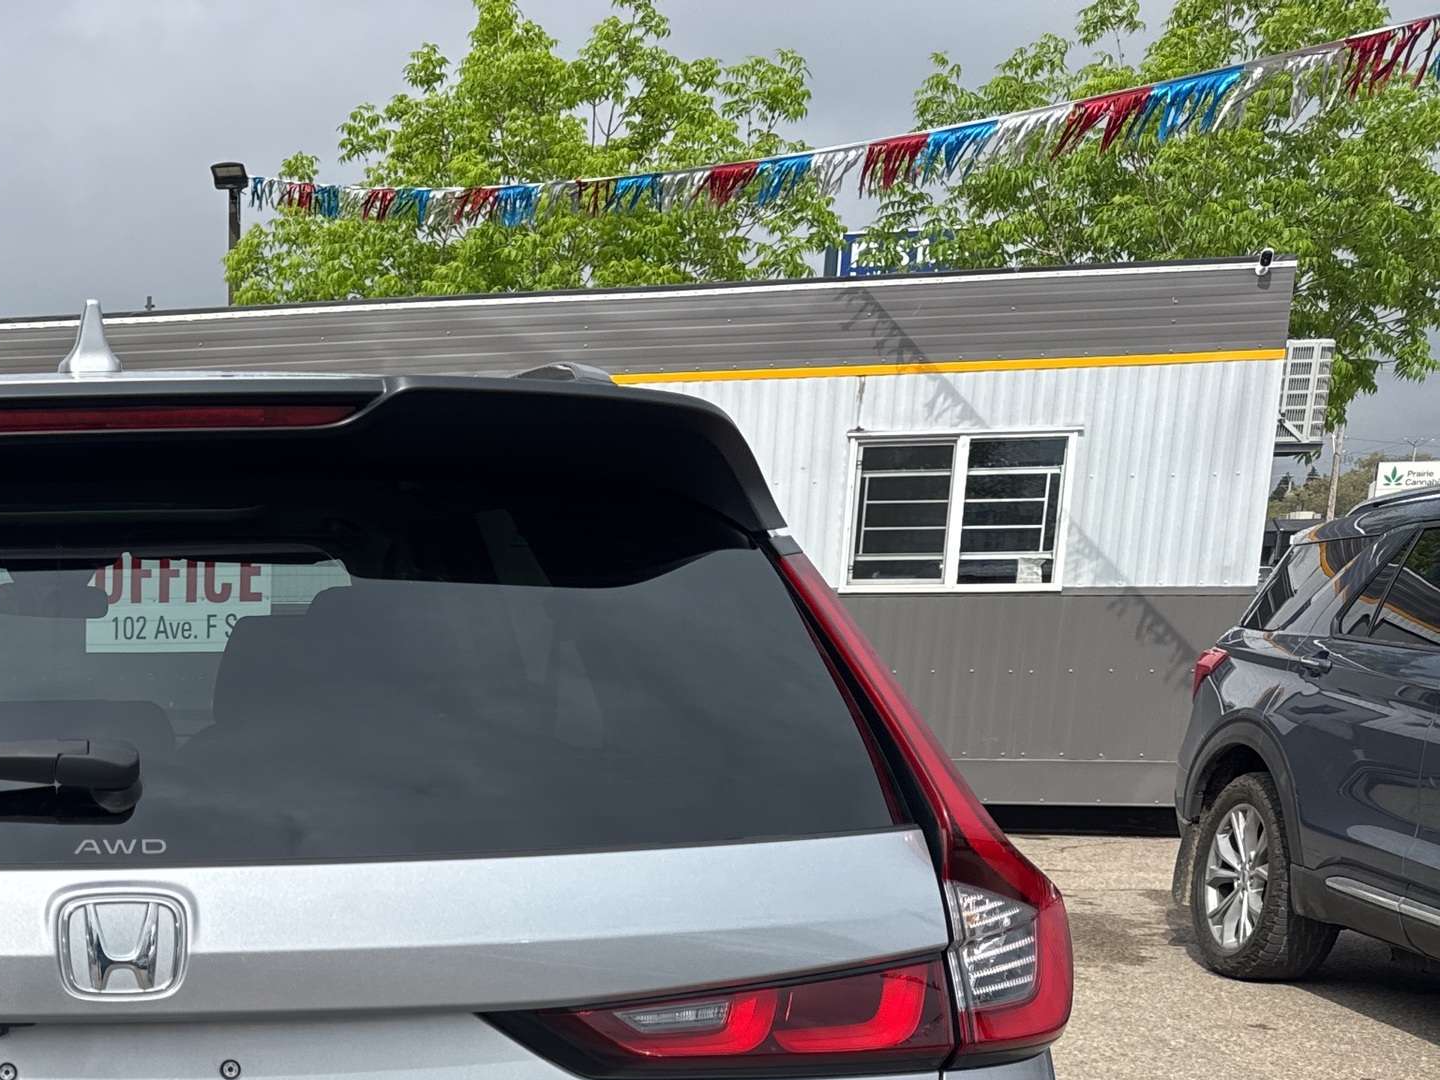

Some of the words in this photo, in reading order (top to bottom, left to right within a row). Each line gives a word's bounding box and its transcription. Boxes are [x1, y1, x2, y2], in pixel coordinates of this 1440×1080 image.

[1407, 470, 1434, 478] Prairie
[95, 557, 263, 604] OFFICE
[112, 615, 147, 640] 102
[154, 615, 198, 640] Ave.
[206, 614, 218, 639] F
[74, 838, 167, 855] AWD
